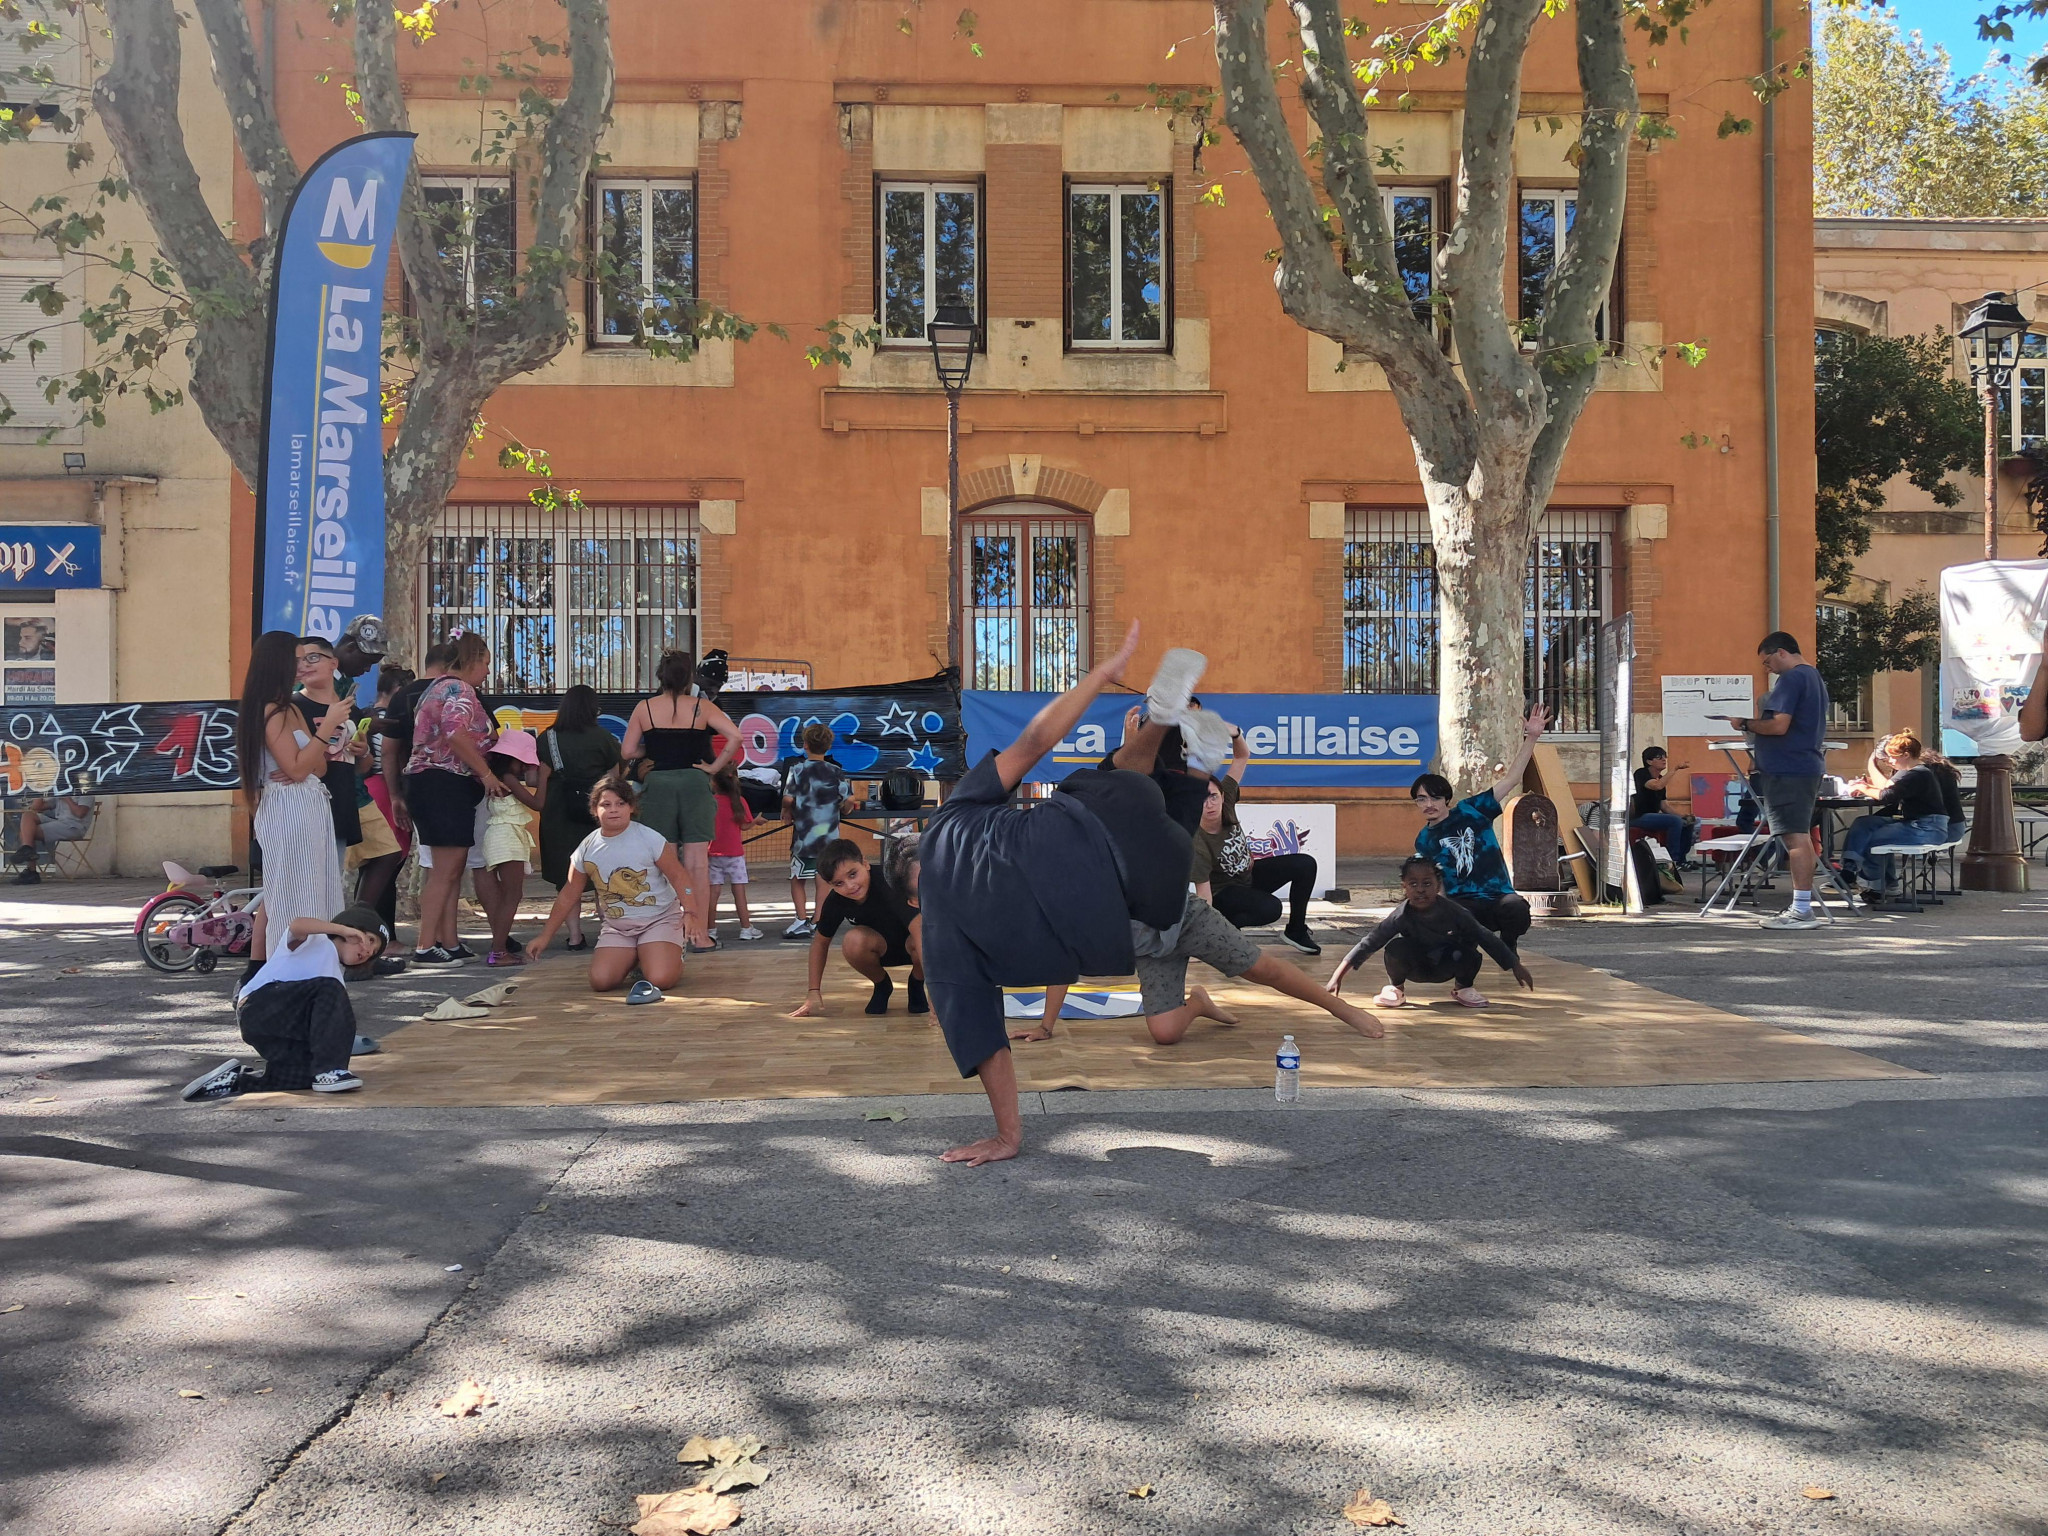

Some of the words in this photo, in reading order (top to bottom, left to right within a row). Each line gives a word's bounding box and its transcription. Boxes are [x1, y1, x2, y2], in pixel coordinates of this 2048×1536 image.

[320, 177, 377, 240] M
[326, 285, 371, 353] La
[283, 433, 308, 586] lamarseillaise.fr
[305, 365, 370, 643] Marseilla
